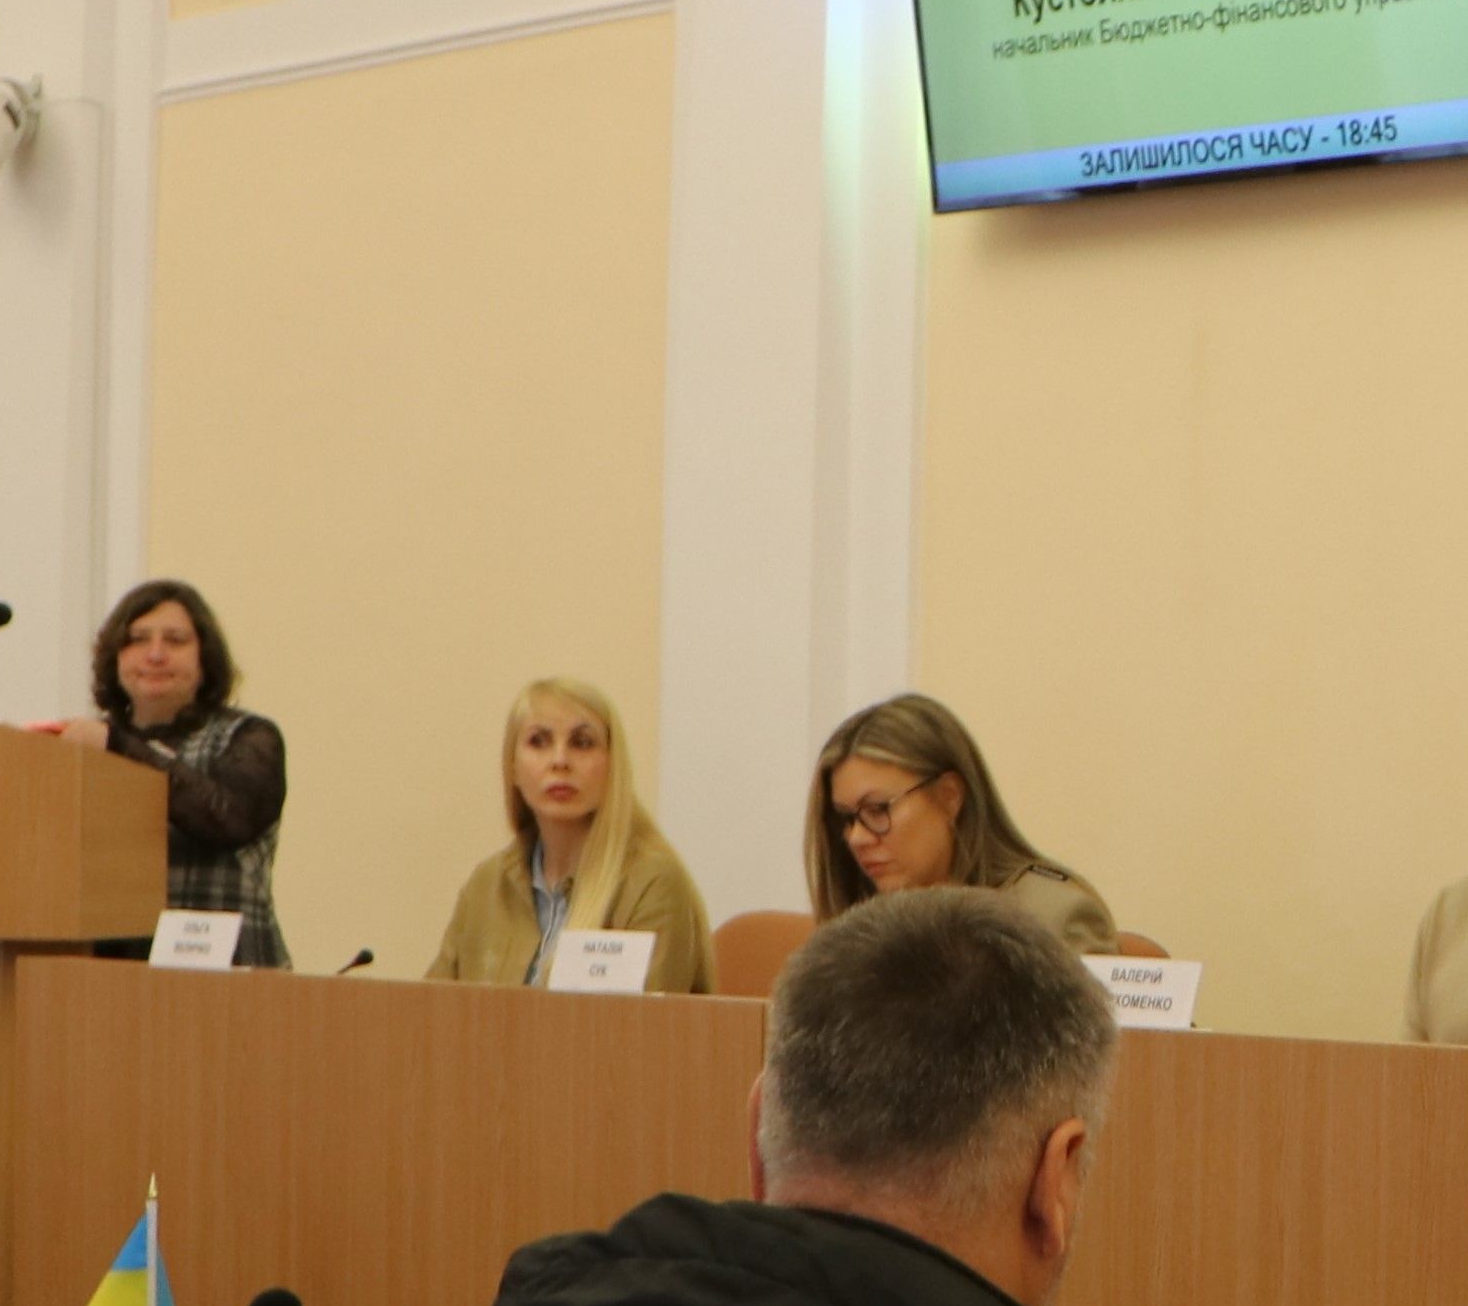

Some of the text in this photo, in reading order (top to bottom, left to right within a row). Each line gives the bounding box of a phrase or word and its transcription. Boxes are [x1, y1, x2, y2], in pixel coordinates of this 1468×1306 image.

[992, 26, 1094, 60] начальник
[1079, 133, 1244, 177] ЗАЛИШИЛОСЯ
[1248, 125, 1315, 157] ЧАСУ
[1337, 115, 1398, 148] 18:45
[1111, 967, 1164, 984] ВАЛЕРІЙ
